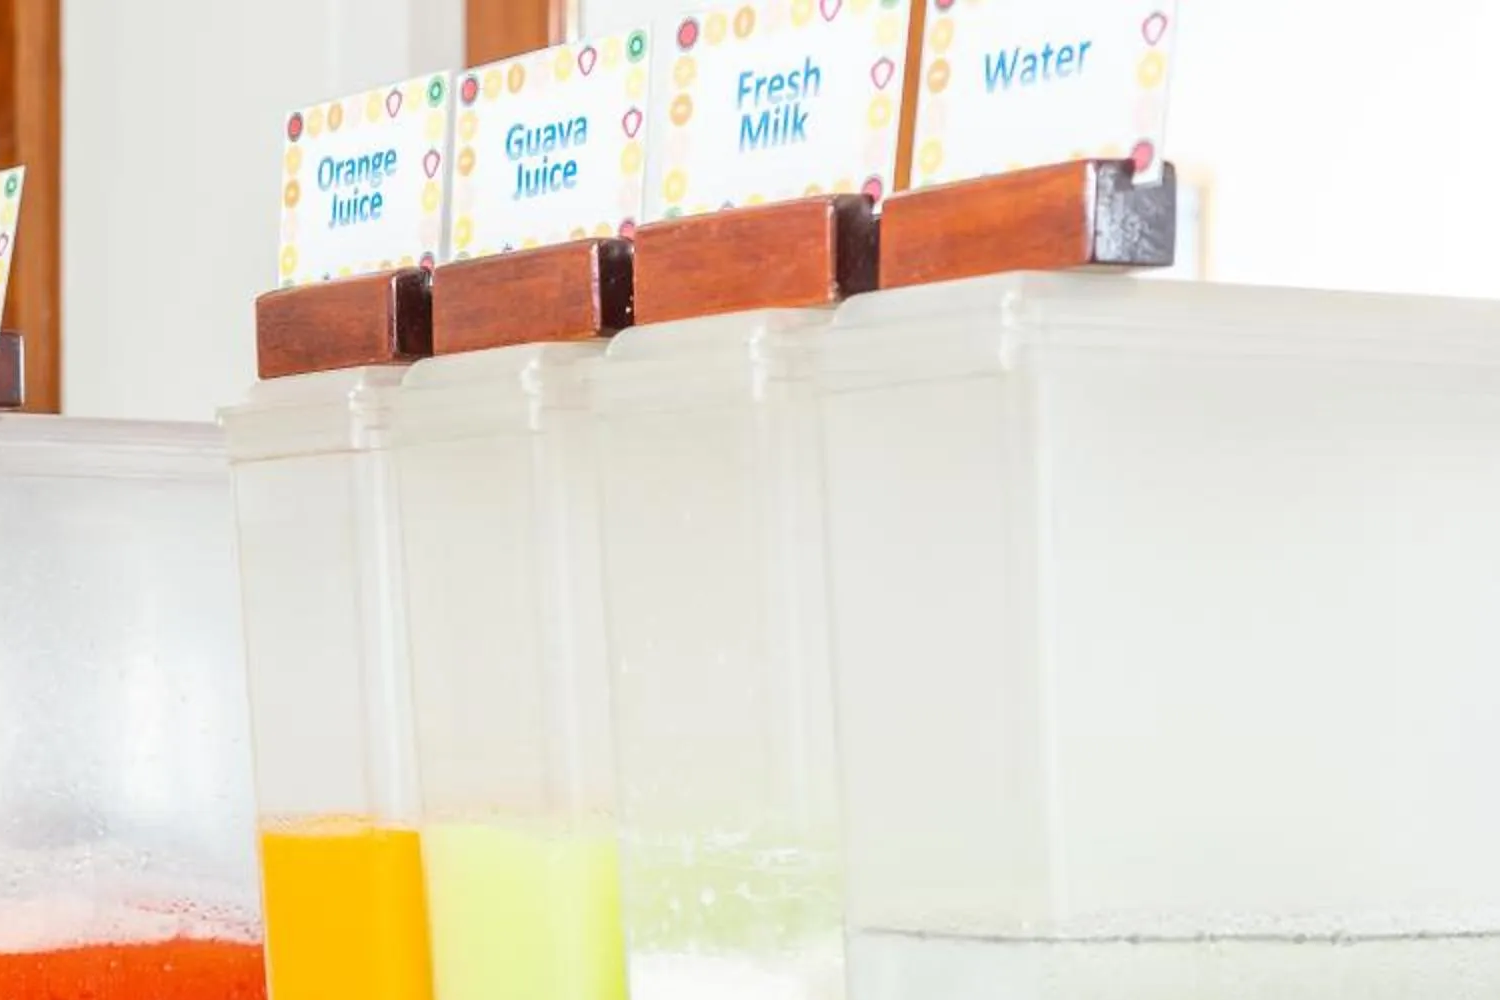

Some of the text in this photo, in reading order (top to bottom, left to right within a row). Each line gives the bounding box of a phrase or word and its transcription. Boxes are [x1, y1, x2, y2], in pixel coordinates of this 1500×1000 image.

[736, 57, 823, 108] Fresh
[984, 39, 1092, 93] Water
[504, 114, 589, 160] Guava
[737, 101, 809, 152] Milk
[316, 147, 398, 191] Orange
[513, 155, 579, 199] Juice
[328, 189, 384, 228] Juice
